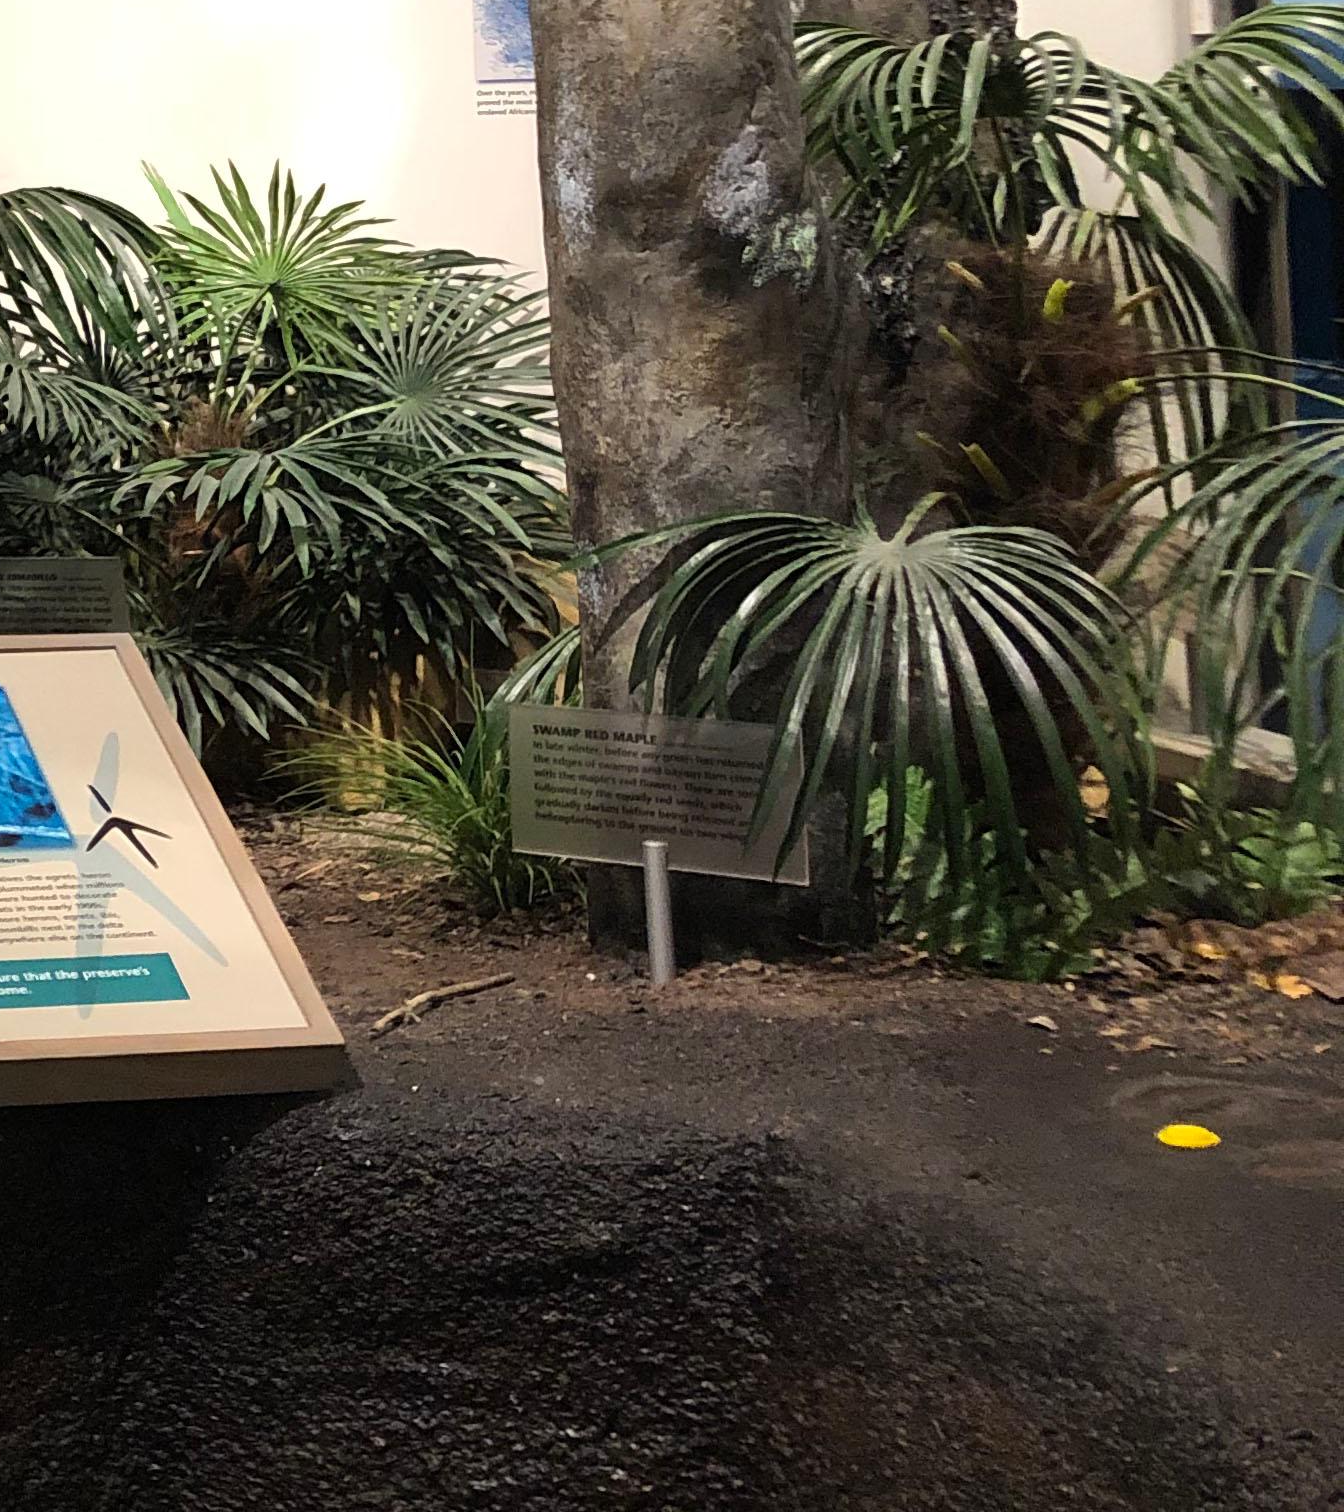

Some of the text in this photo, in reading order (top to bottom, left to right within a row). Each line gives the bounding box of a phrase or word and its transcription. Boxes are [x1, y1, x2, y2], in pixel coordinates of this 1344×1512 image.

[532, 724, 657, 746] SWAMP RED MAPLE
[22, 972, 52, 982] that
[54, 971, 79, 980] the
[82, 967, 150, 981] preserve's
